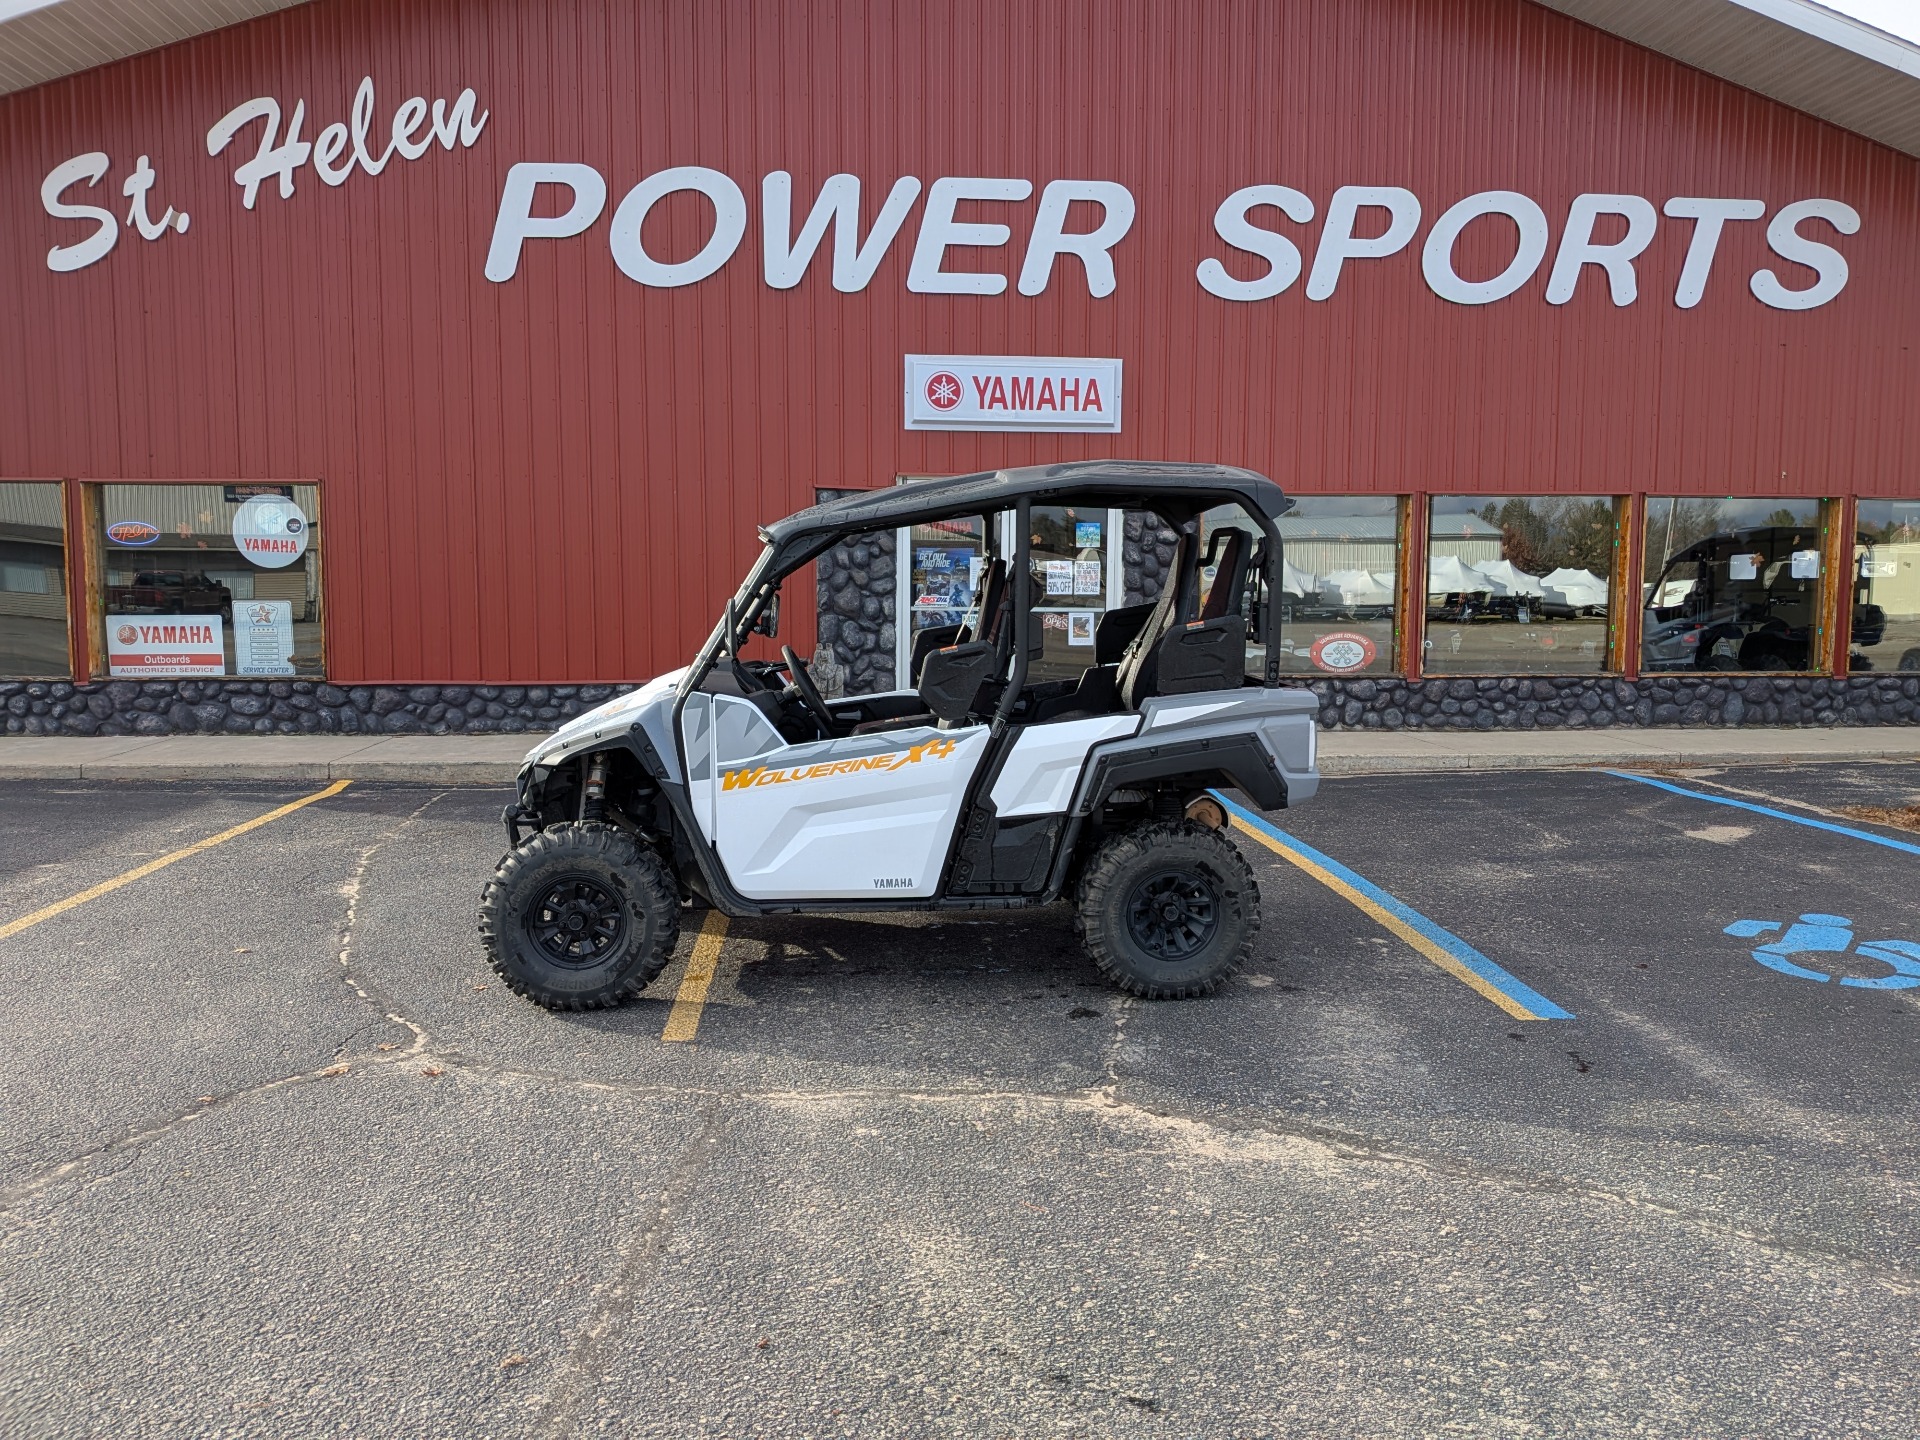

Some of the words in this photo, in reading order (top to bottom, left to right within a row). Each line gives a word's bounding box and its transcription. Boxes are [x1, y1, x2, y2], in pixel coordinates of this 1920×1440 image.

[40, 151, 190, 272] St.
[206, 75, 489, 210] Helen
[484, 162, 1136, 298] POWER
[1196, 183, 1862, 310] SPORTS
[971, 374, 1104, 413] YAMAHA
[932, 521, 973, 533] YAMAHA
[244, 537, 298, 554] YAMAHA
[918, 552, 932, 561] GET
[932, 552, 947, 561] OUT
[920, 560, 935, 568] AND
[935, 559, 952, 568] RIDE
[1060, 581, 1071, 593] OFF
[917, 596, 948, 604] AMSOIL
[1045, 616, 1068, 628] OPEN
[139, 625, 214, 644] YAMAHA
[144, 655, 191, 664] Outboards
[120, 666, 177, 674] AUTHORIZED
[242, 666, 266, 674] SERVICE
[266, 666, 290, 674] CENTER
[721, 754, 898, 791] WOLVERINE
[886, 738, 957, 772] X4
[873, 877, 914, 889] YAMAHA
